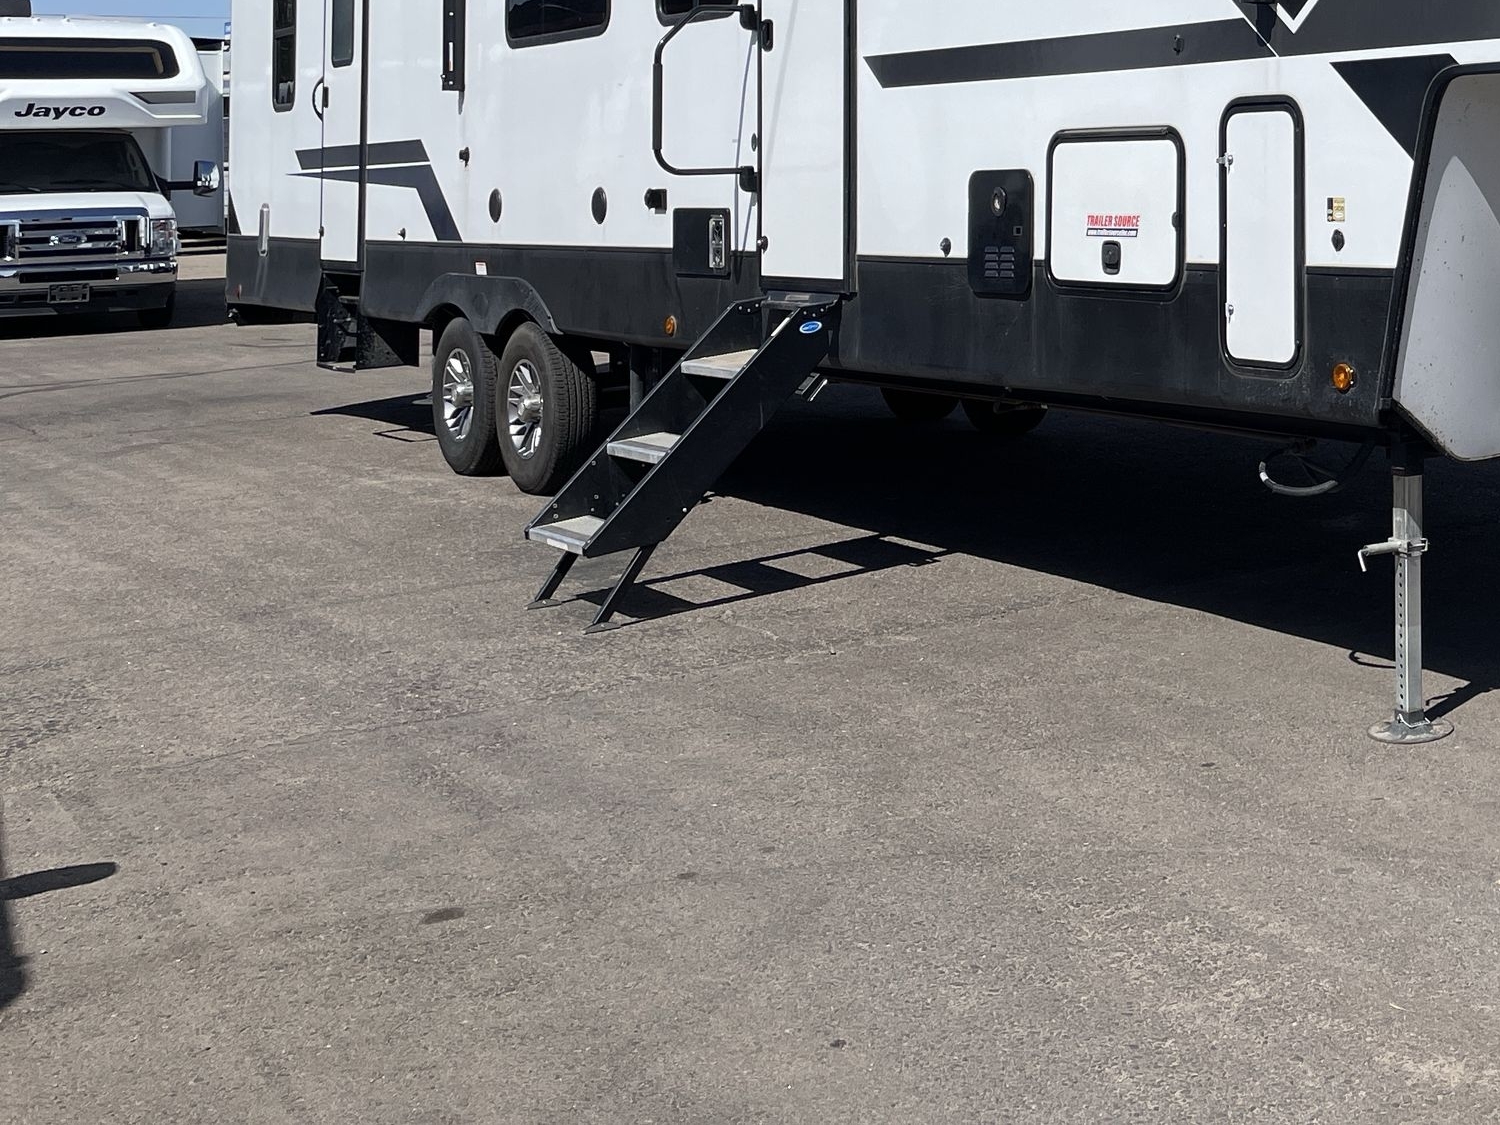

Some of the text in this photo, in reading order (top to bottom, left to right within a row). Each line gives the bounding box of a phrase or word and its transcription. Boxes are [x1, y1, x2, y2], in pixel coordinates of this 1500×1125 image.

[14, 103, 106, 120] Jayco
[1087, 215, 1140, 227] TRAILER SOURCE
